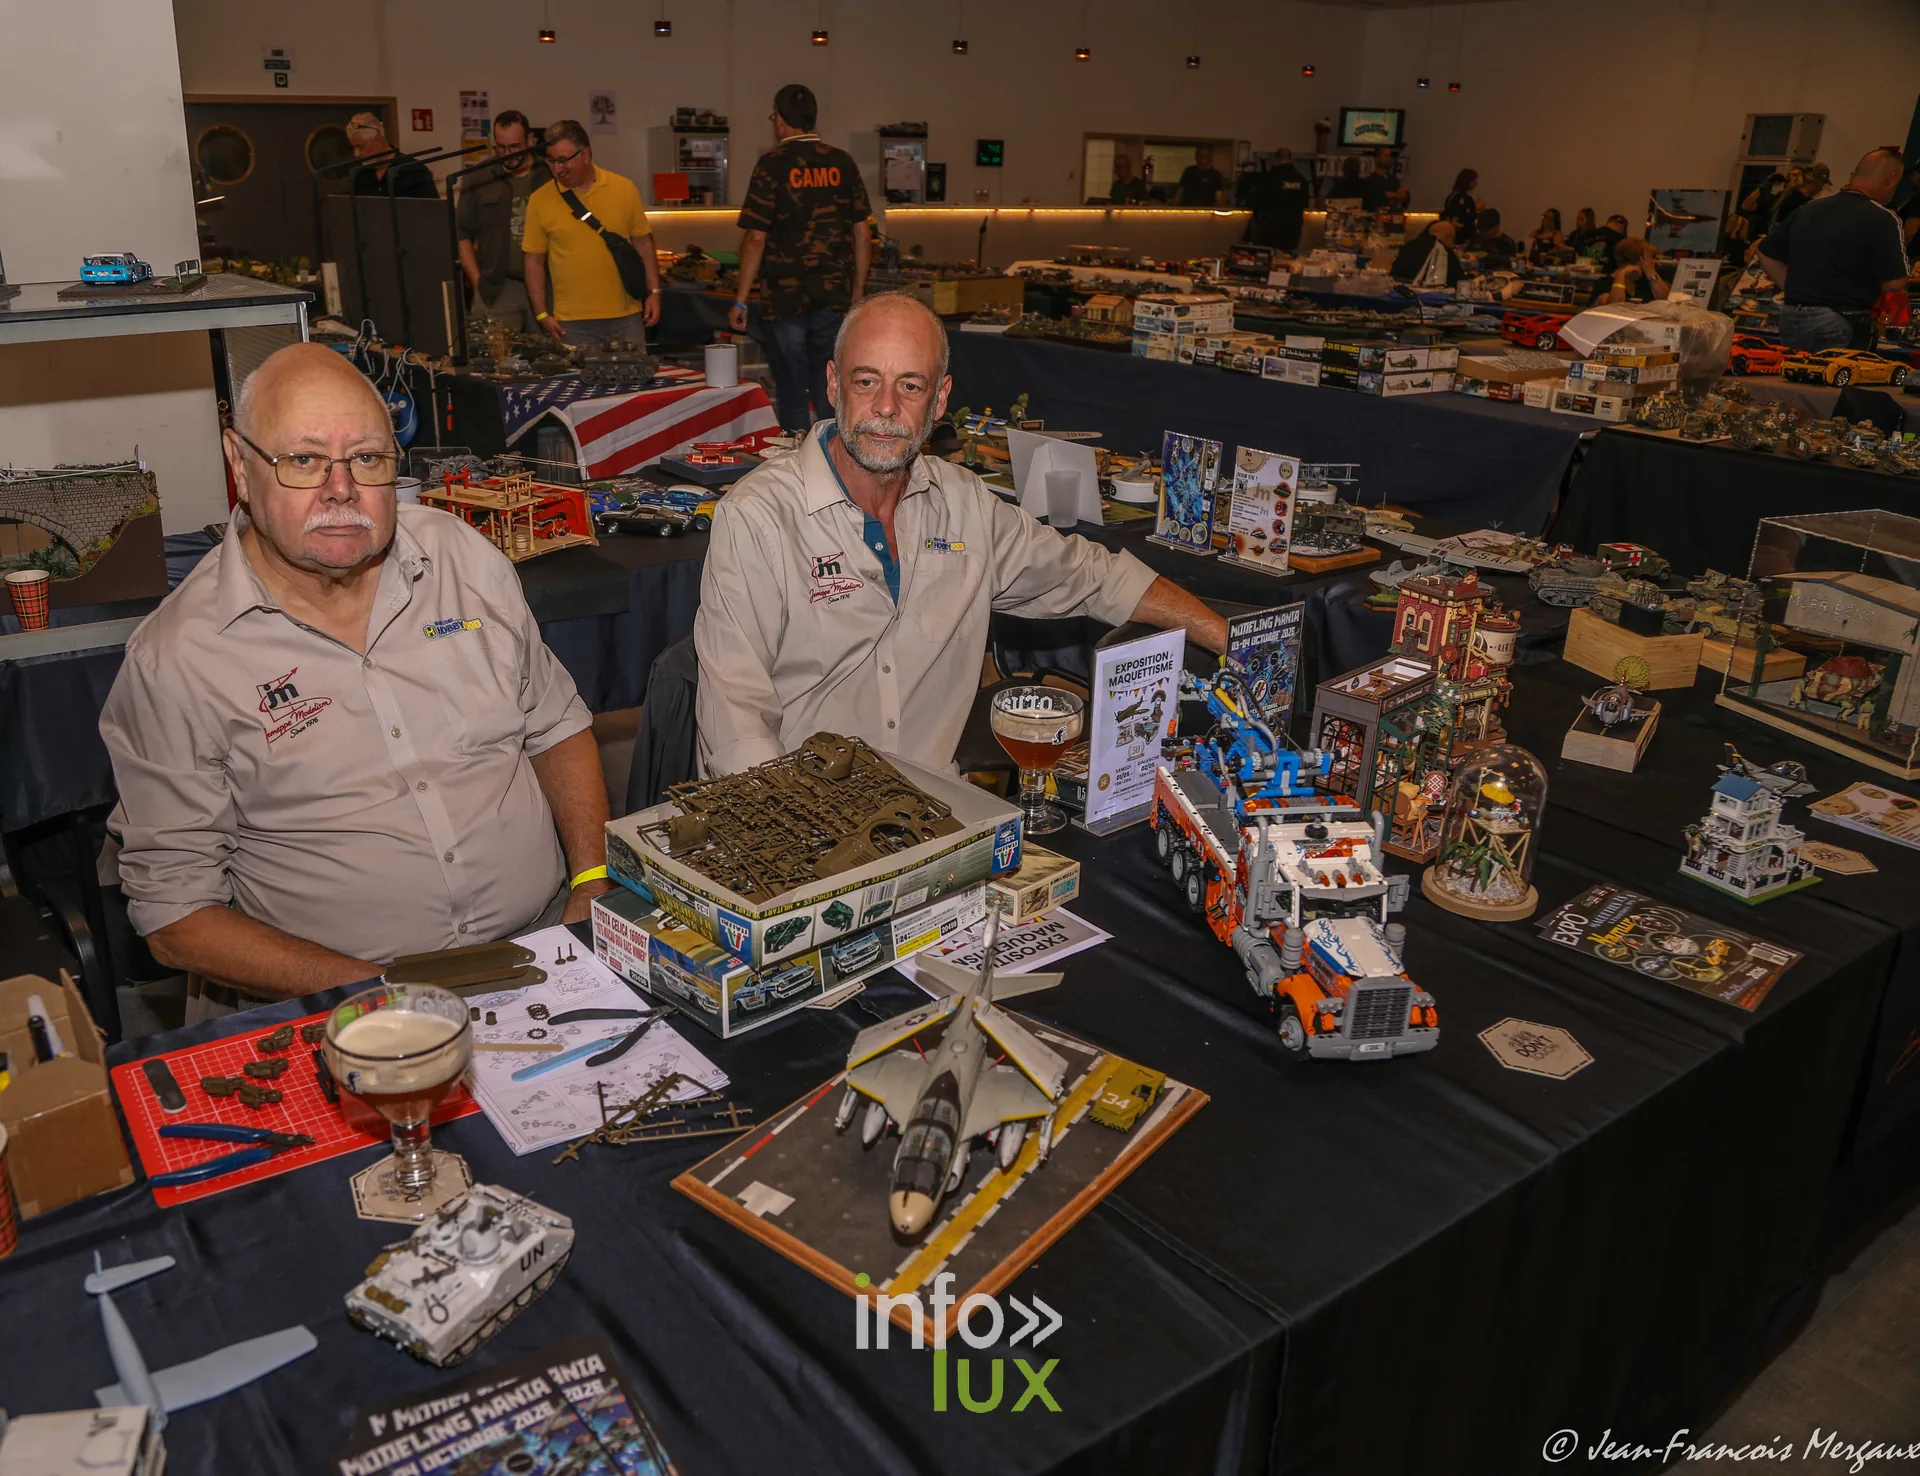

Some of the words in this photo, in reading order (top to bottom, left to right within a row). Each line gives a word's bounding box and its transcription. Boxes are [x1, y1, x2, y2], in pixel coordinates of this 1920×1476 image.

[789, 166, 841, 188] CAMO
[1230, 616, 1273, 638] MODELING
[1274, 610, 1300, 626] MANIA
[1231, 639, 1250, 651] 03-04
[1251, 630, 1280, 646] OCTOBRE
[1115, 651, 1169, 674] EXPOSITION
[1109, 660, 1173, 688] MAQUETTISME
[291, 701, 330, 722] Modelism
[290, 725, 306, 739] Since
[871, 871, 899, 884] VEHICLES
[836, 883, 862, 895] MILITARY
[708, 893, 732, 909] VEHICLES
[763, 905, 793, 917] MILITARY
[803, 895, 833, 906] VEHICLES
[594, 906, 610, 926] TOYOTA
[611, 917, 628, 938] CELICA
[629, 929, 647, 949] 1600GT
[721, 918, 748, 936] ITALERI
[941, 919, 957, 935] 20498
[1552, 912, 1589, 947] EXPO
[1587, 917, 1635, 947] Namur
[1515, 1036, 1553, 1058] DON'T
[1102, 1092, 1130, 1109] 34
[520, 1241, 545, 1272] UN
[338, 1410, 473, 1476] MODELING
[471, 1376, 552, 1424] MANIA
[419, 1423, 509, 1473] OCTOBRE
